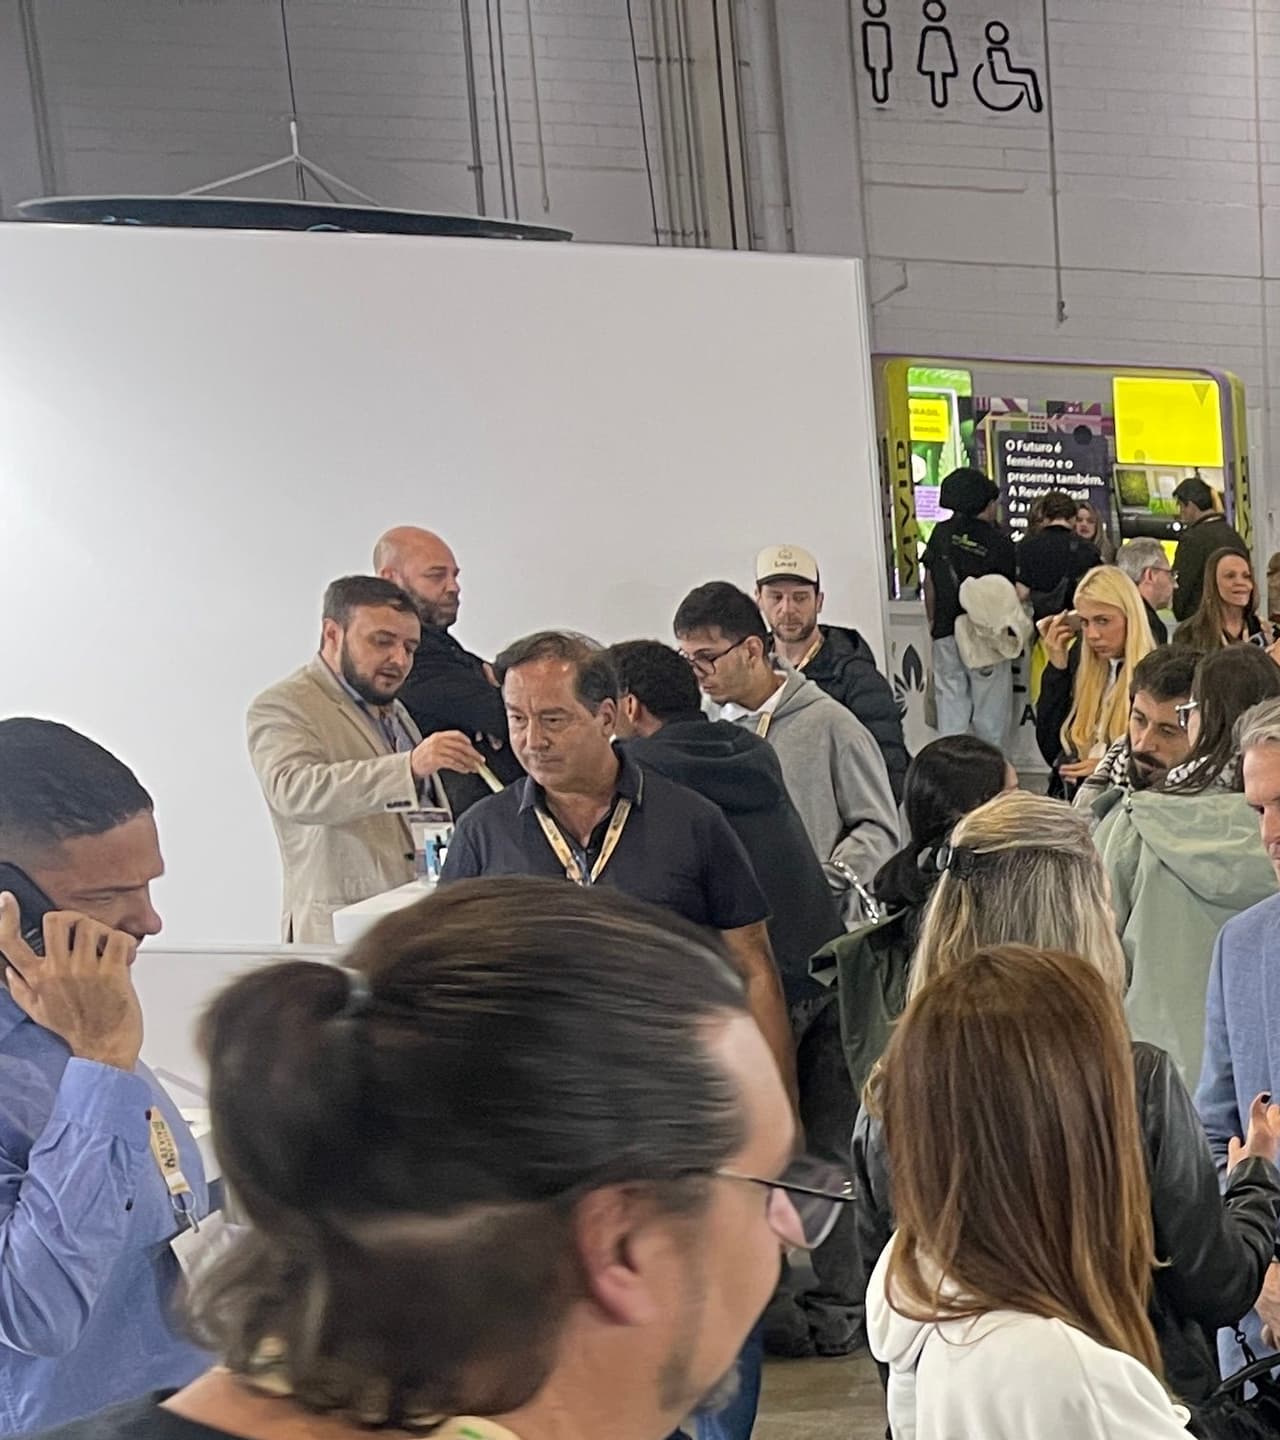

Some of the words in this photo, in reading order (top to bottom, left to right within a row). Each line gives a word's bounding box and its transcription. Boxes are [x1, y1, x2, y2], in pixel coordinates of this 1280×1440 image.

[1005, 439, 1016, 451] O
[1017, 440, 1053, 453] Futuro
[1006, 454, 1054, 469] feminino
[1056, 460, 1063, 469] e
[1065, 460, 1073, 469] o
[1007, 472, 1054, 484] presente
[1056, 473, 1105, 486] também.
[1008, 485, 1017, 497] A
